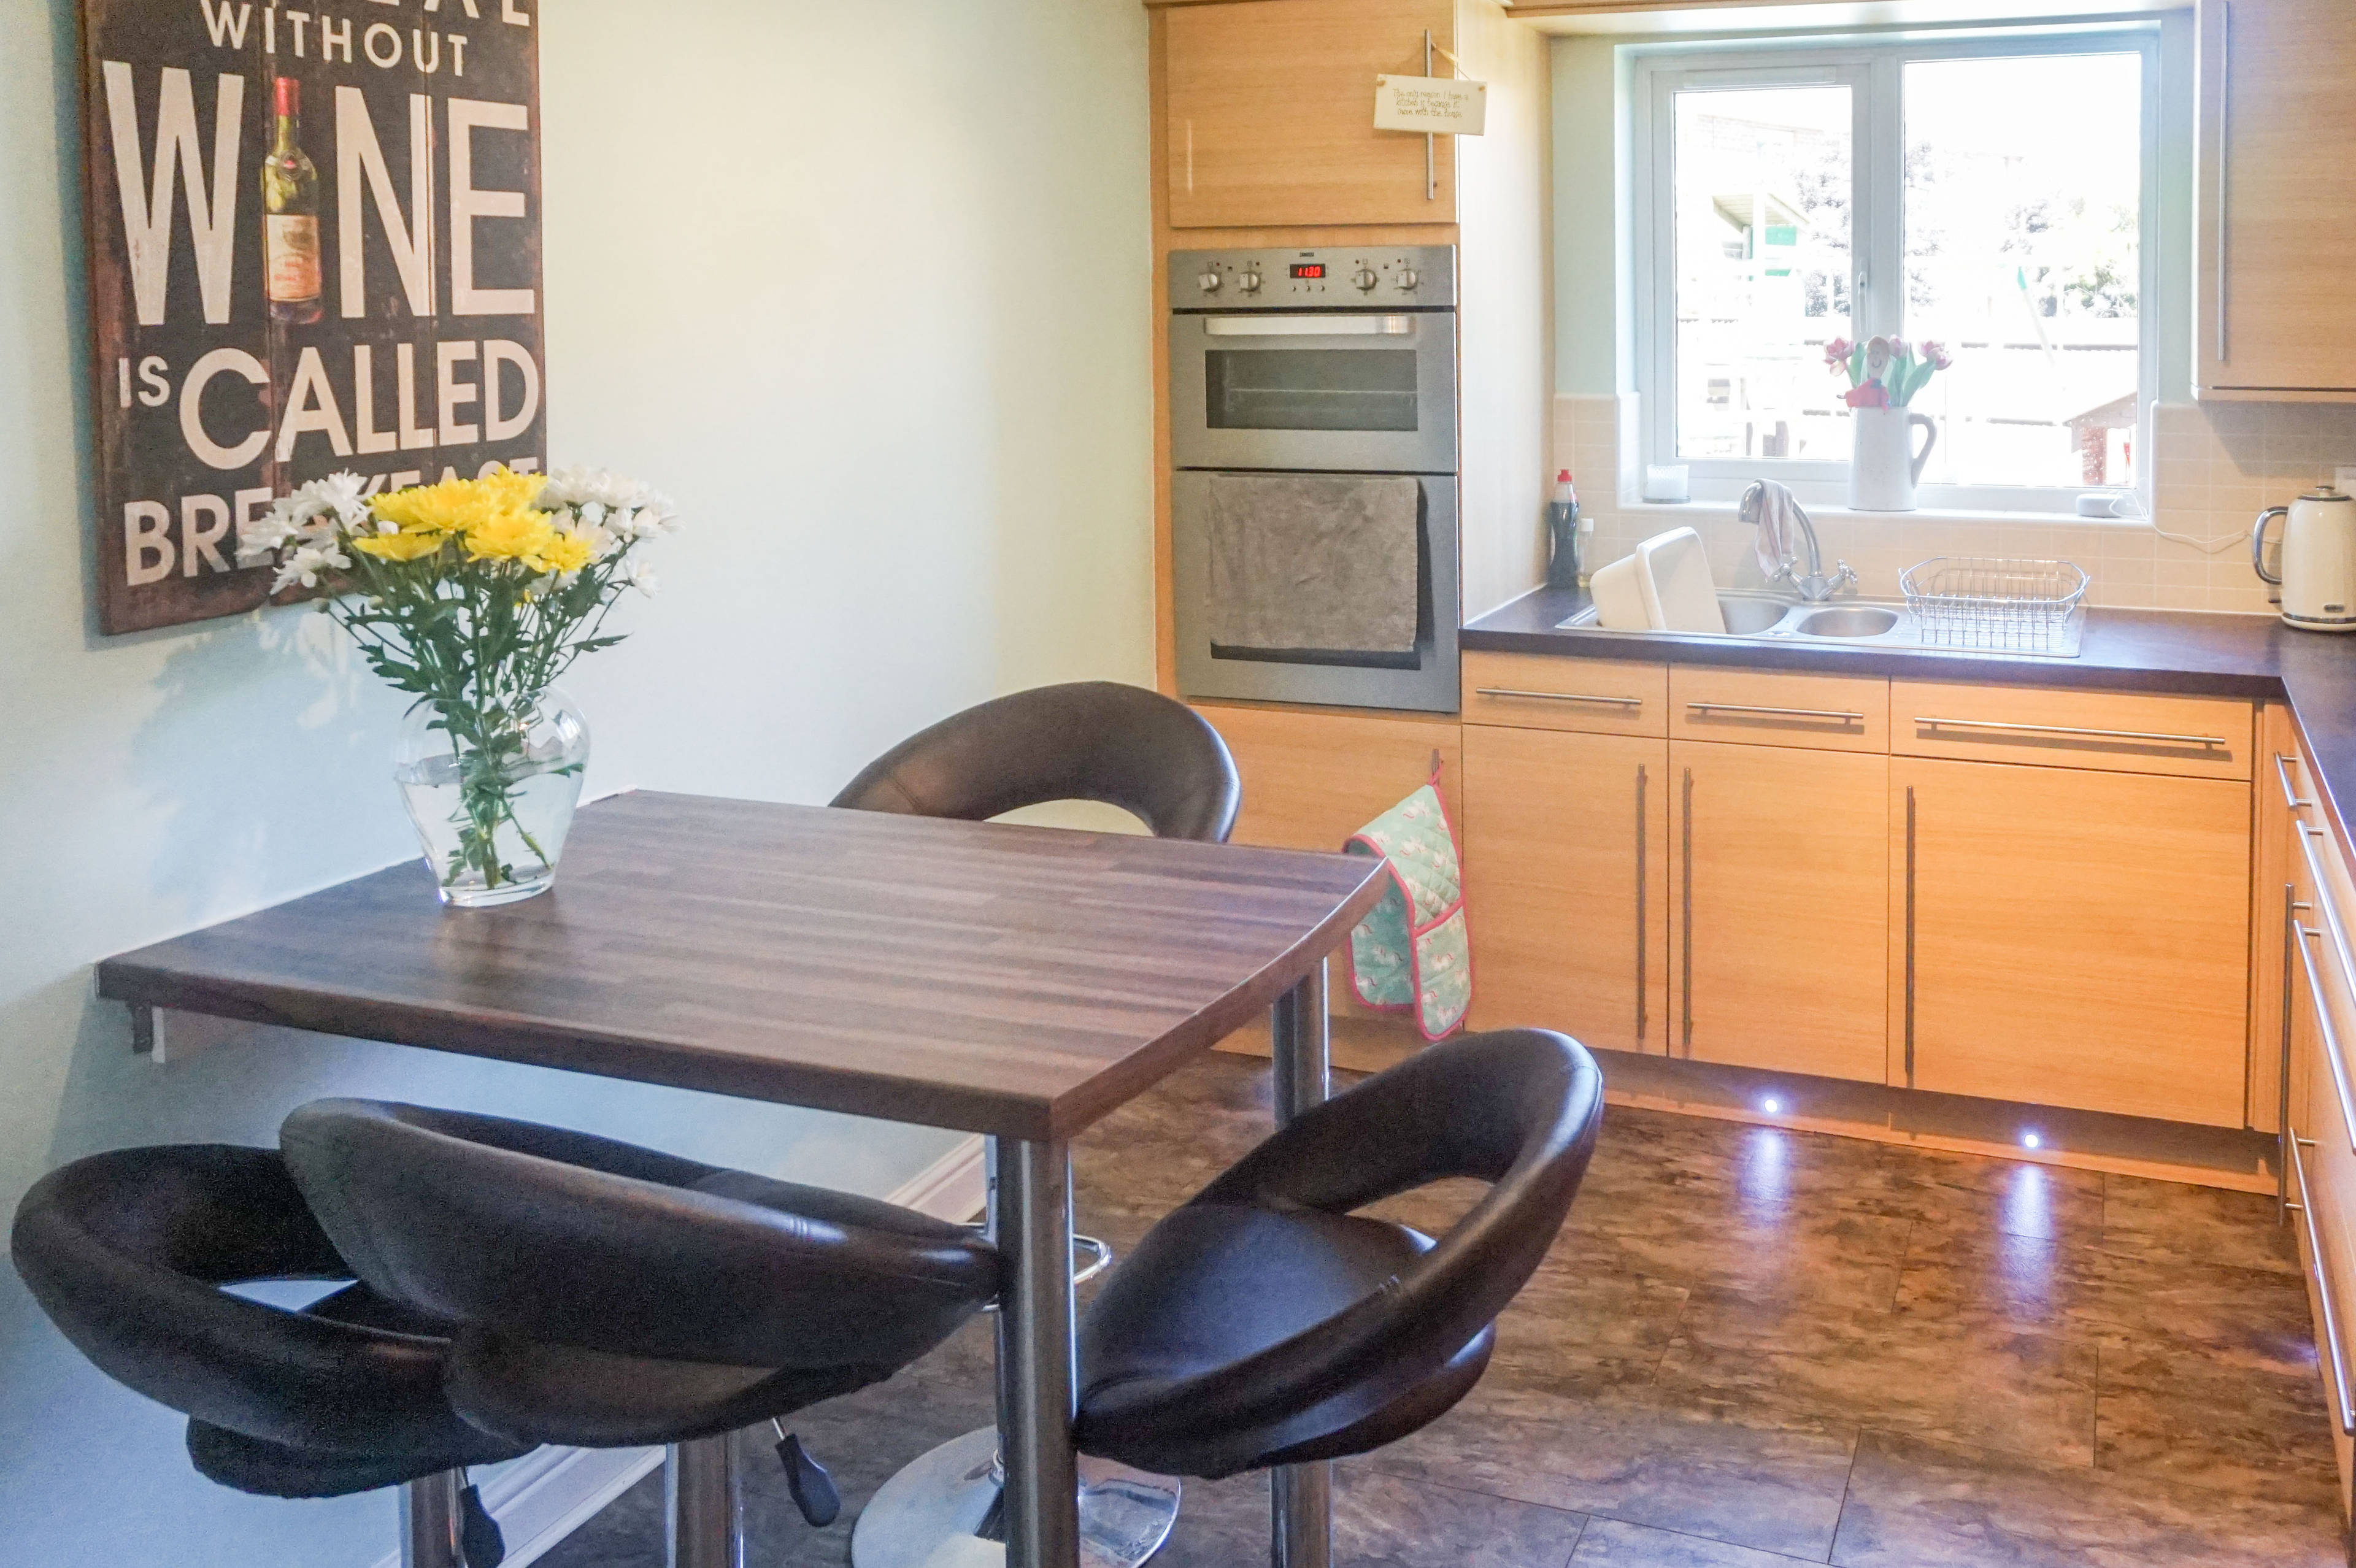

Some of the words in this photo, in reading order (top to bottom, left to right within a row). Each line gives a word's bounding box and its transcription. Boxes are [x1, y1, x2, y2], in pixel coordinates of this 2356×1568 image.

[200, 0, 468, 77] WITHOUT
[118, 355, 171, 408] IS
[179, 339, 539, 470] CALLED
